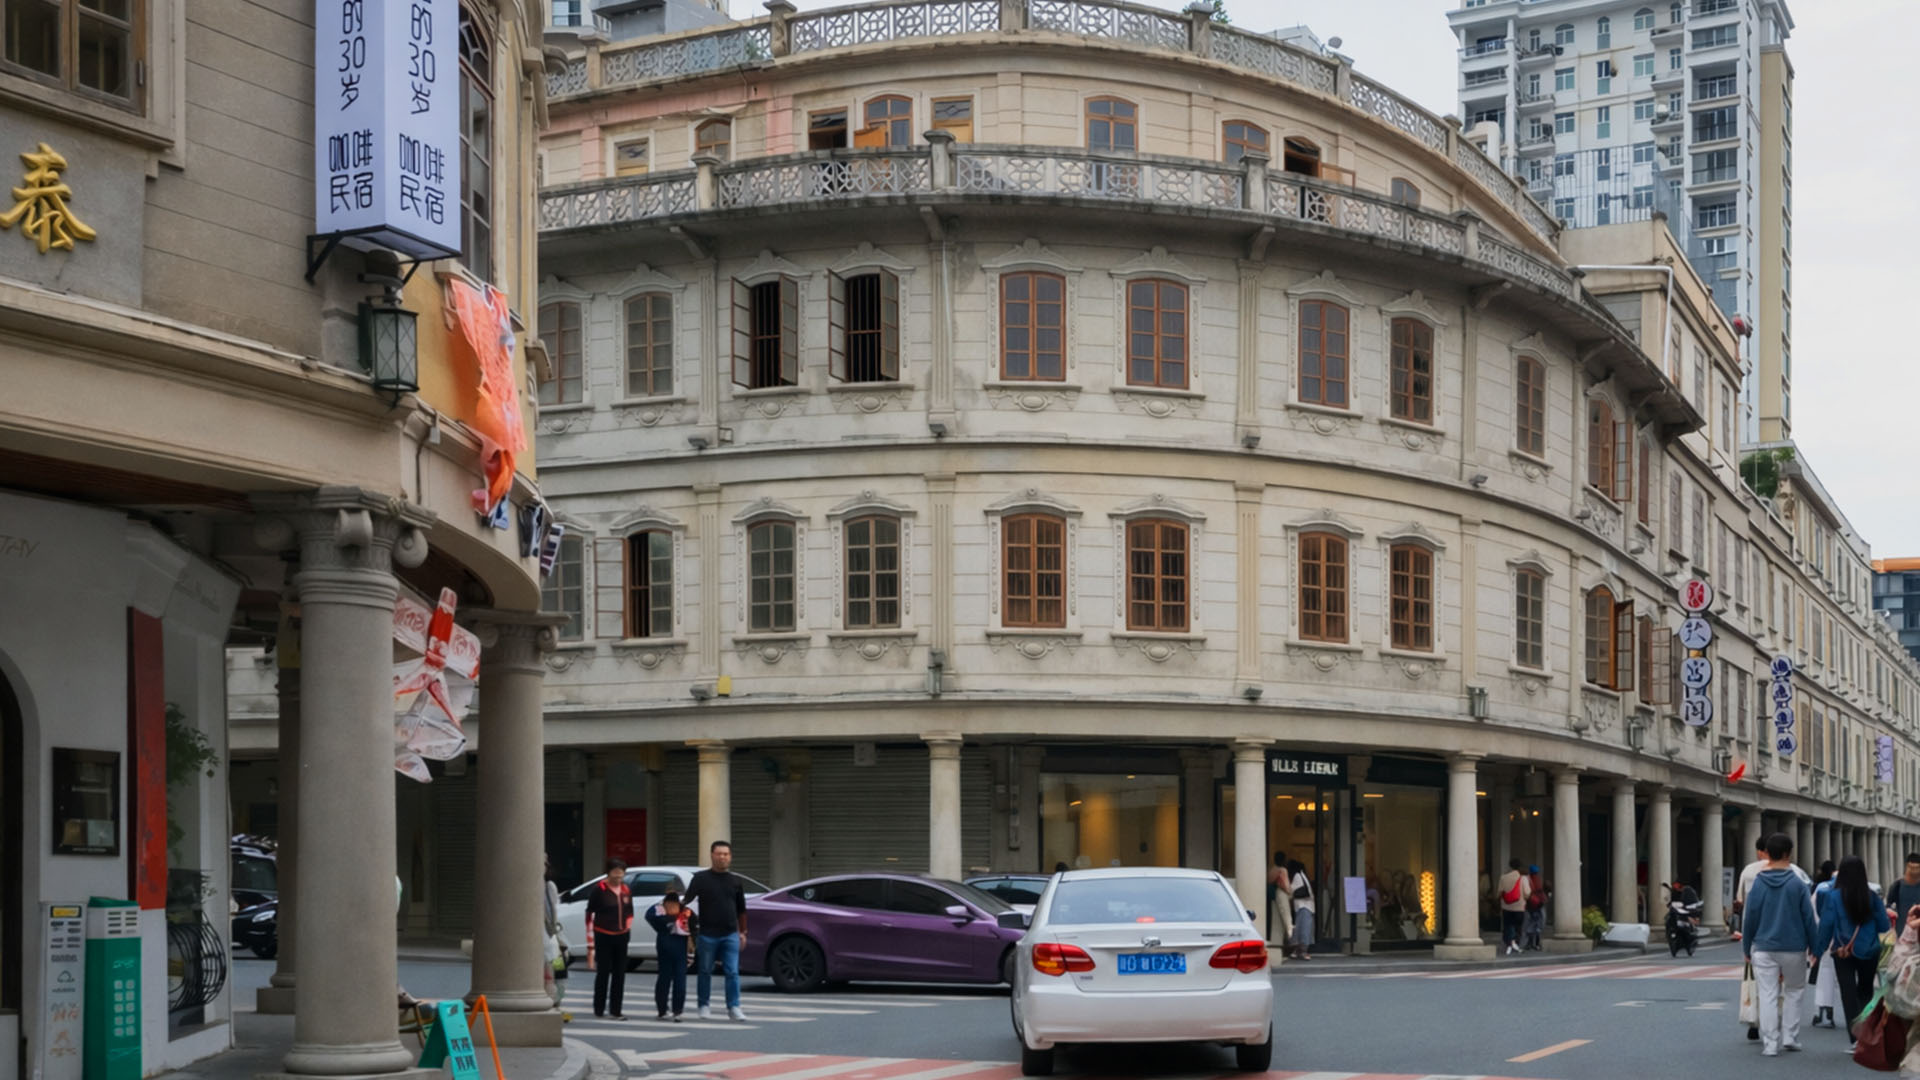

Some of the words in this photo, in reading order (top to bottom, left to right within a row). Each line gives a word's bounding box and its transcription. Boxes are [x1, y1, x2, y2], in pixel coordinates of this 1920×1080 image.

[408, 0, 436, 115] 的30岁
[328, 128, 374, 173] 咖啡
[399, 132, 446, 184] 咖啡
[330, 171, 374, 214] 民宿
[400, 174, 446, 225] 民宿
